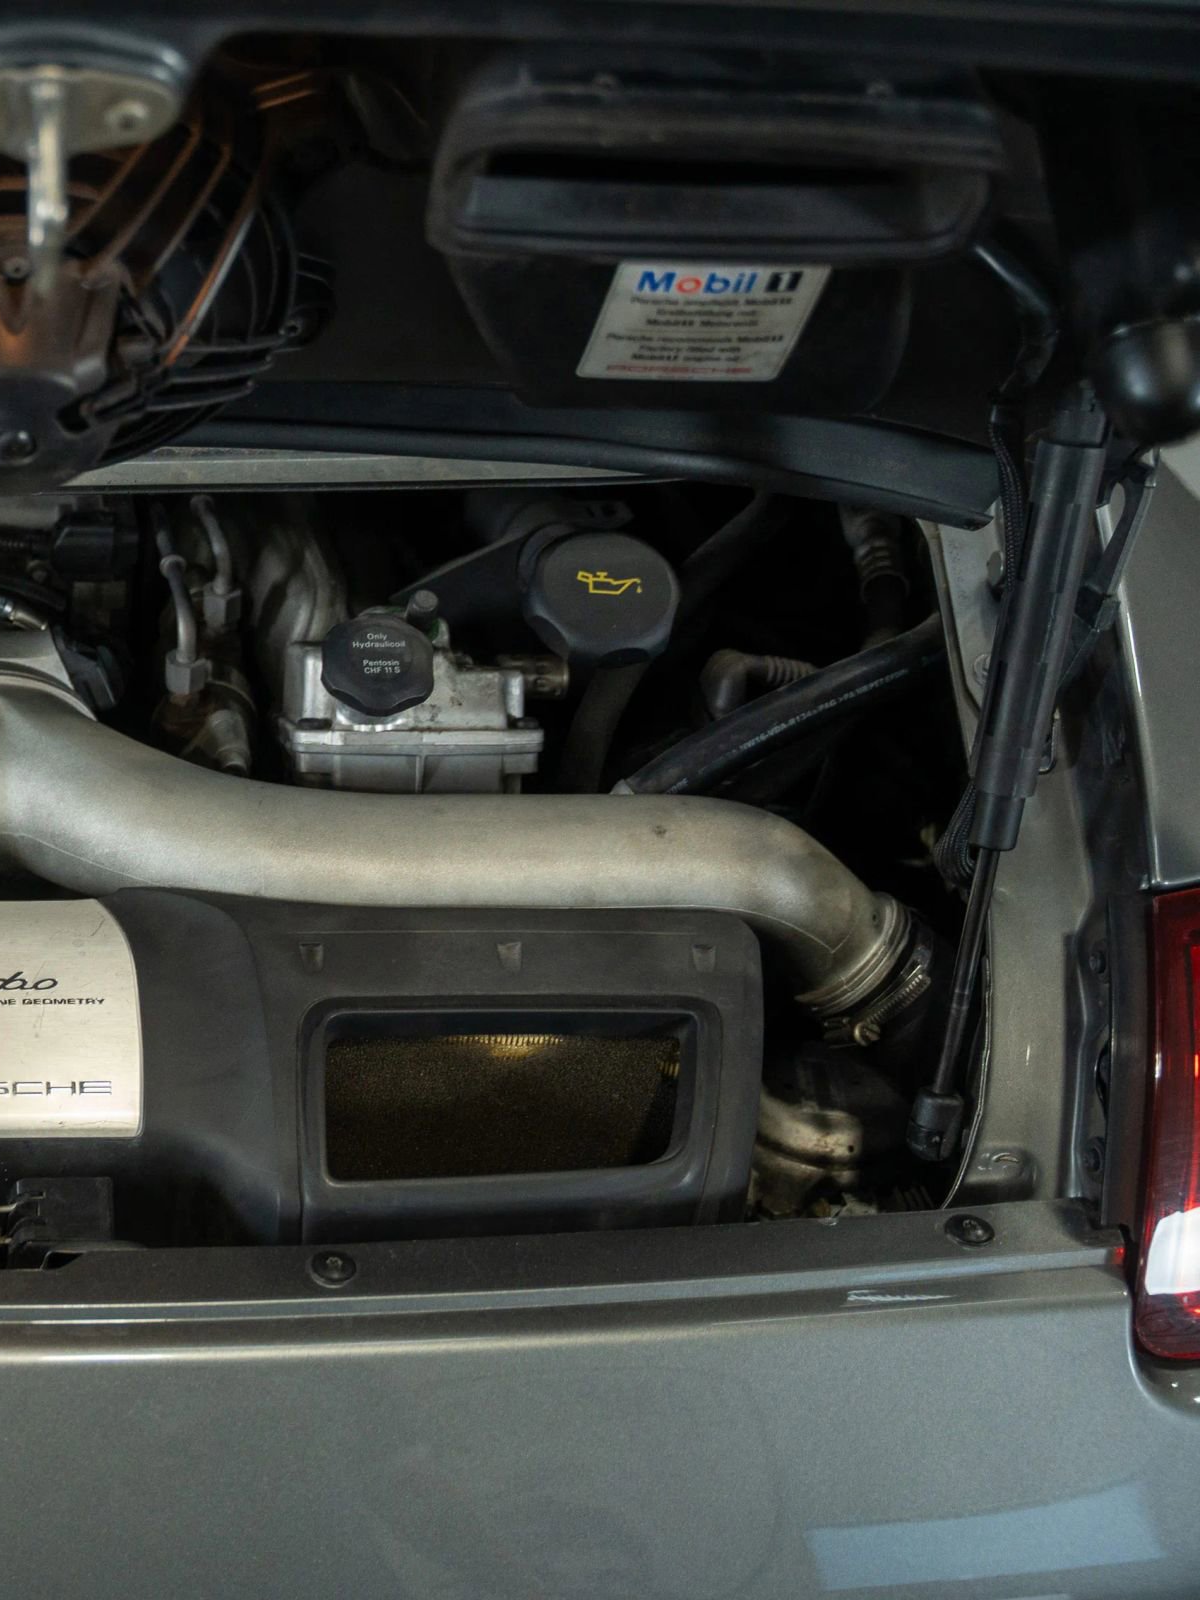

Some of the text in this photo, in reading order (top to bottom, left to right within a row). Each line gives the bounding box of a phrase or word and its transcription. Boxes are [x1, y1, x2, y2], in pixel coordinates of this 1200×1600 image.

[637, 271, 803, 294] Mobil 1
[367, 632, 388, 640] Only
[352, 640, 406, 649] Hydraulicoil
[363, 666, 382, 674] CHF
[384, 666, 393, 674] 11
[21, 998, 105, 1006] GEOMETRY
